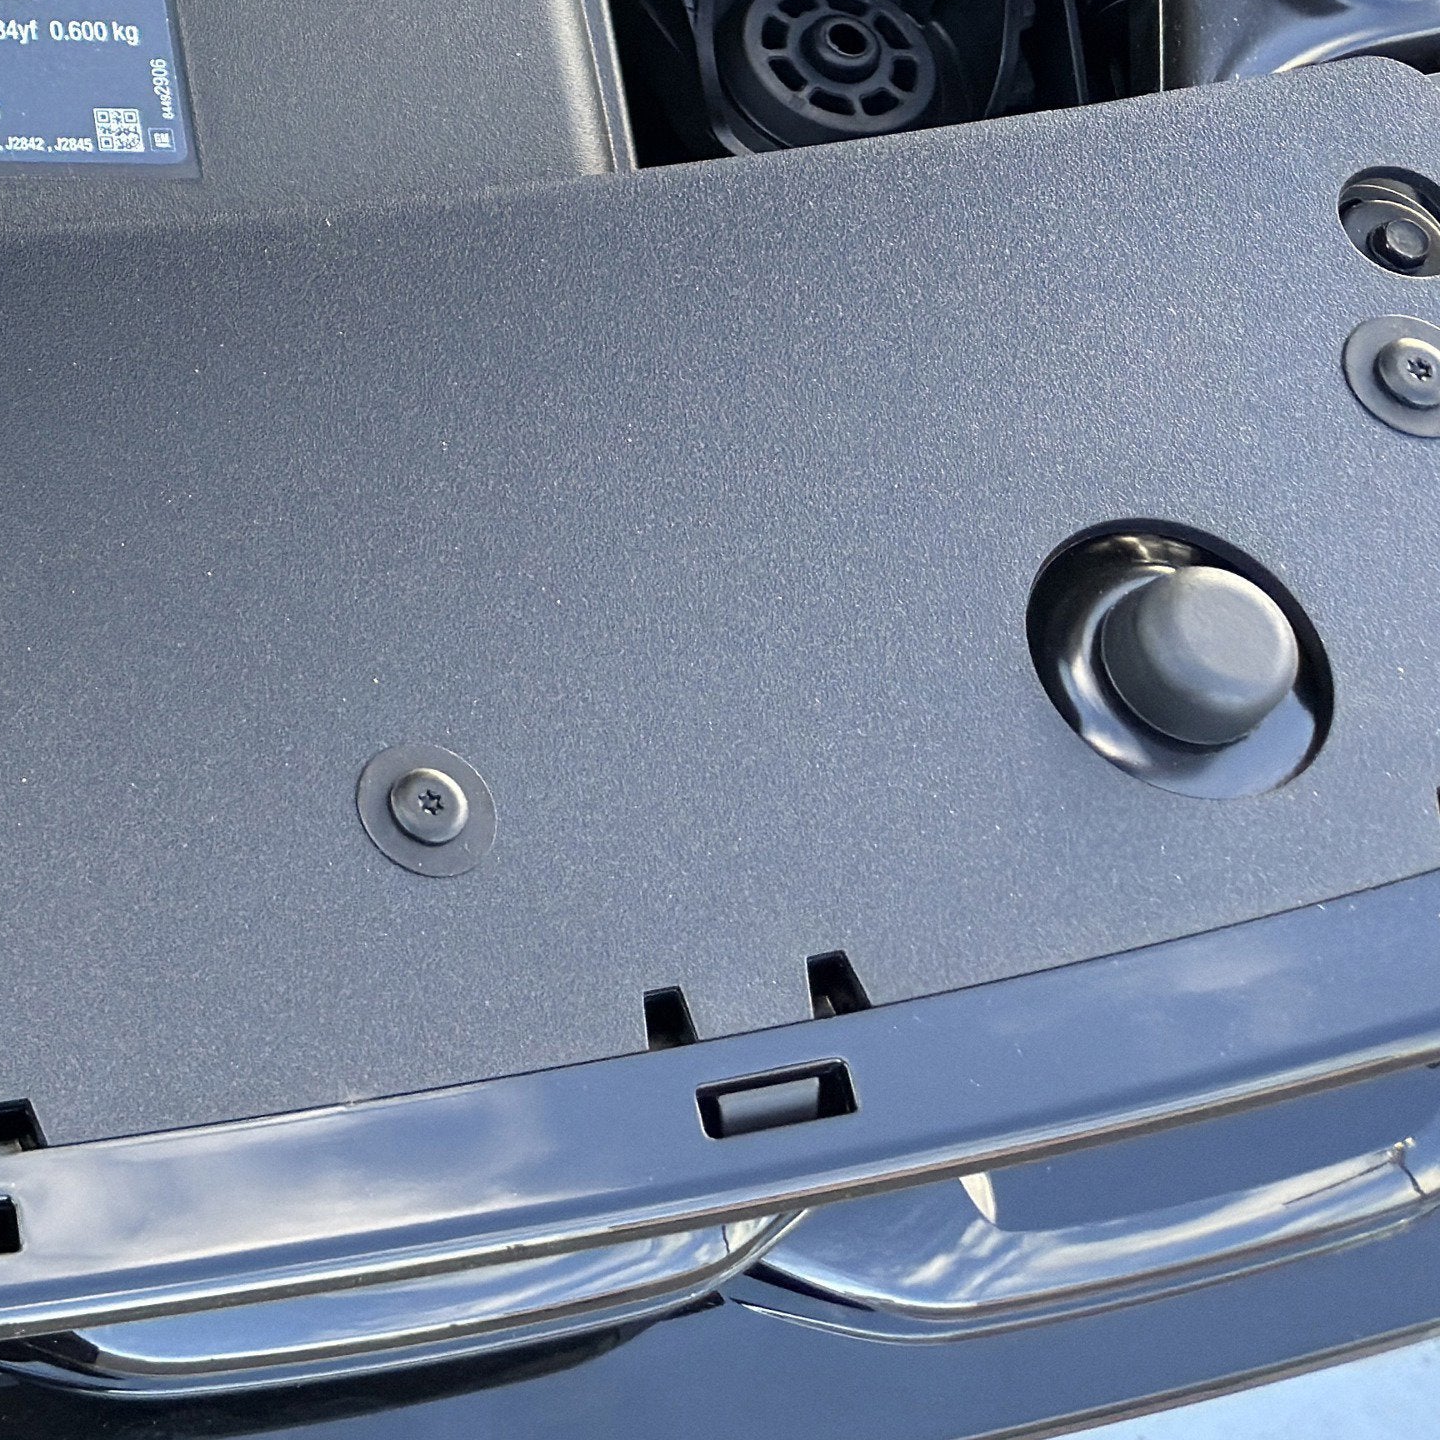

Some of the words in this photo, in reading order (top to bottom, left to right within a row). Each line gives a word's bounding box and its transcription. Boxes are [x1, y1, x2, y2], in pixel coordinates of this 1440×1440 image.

[49, 21, 108, 42] 0.600
[112, 22, 140, 46] kg
[54, 138, 93, 153] J2845
